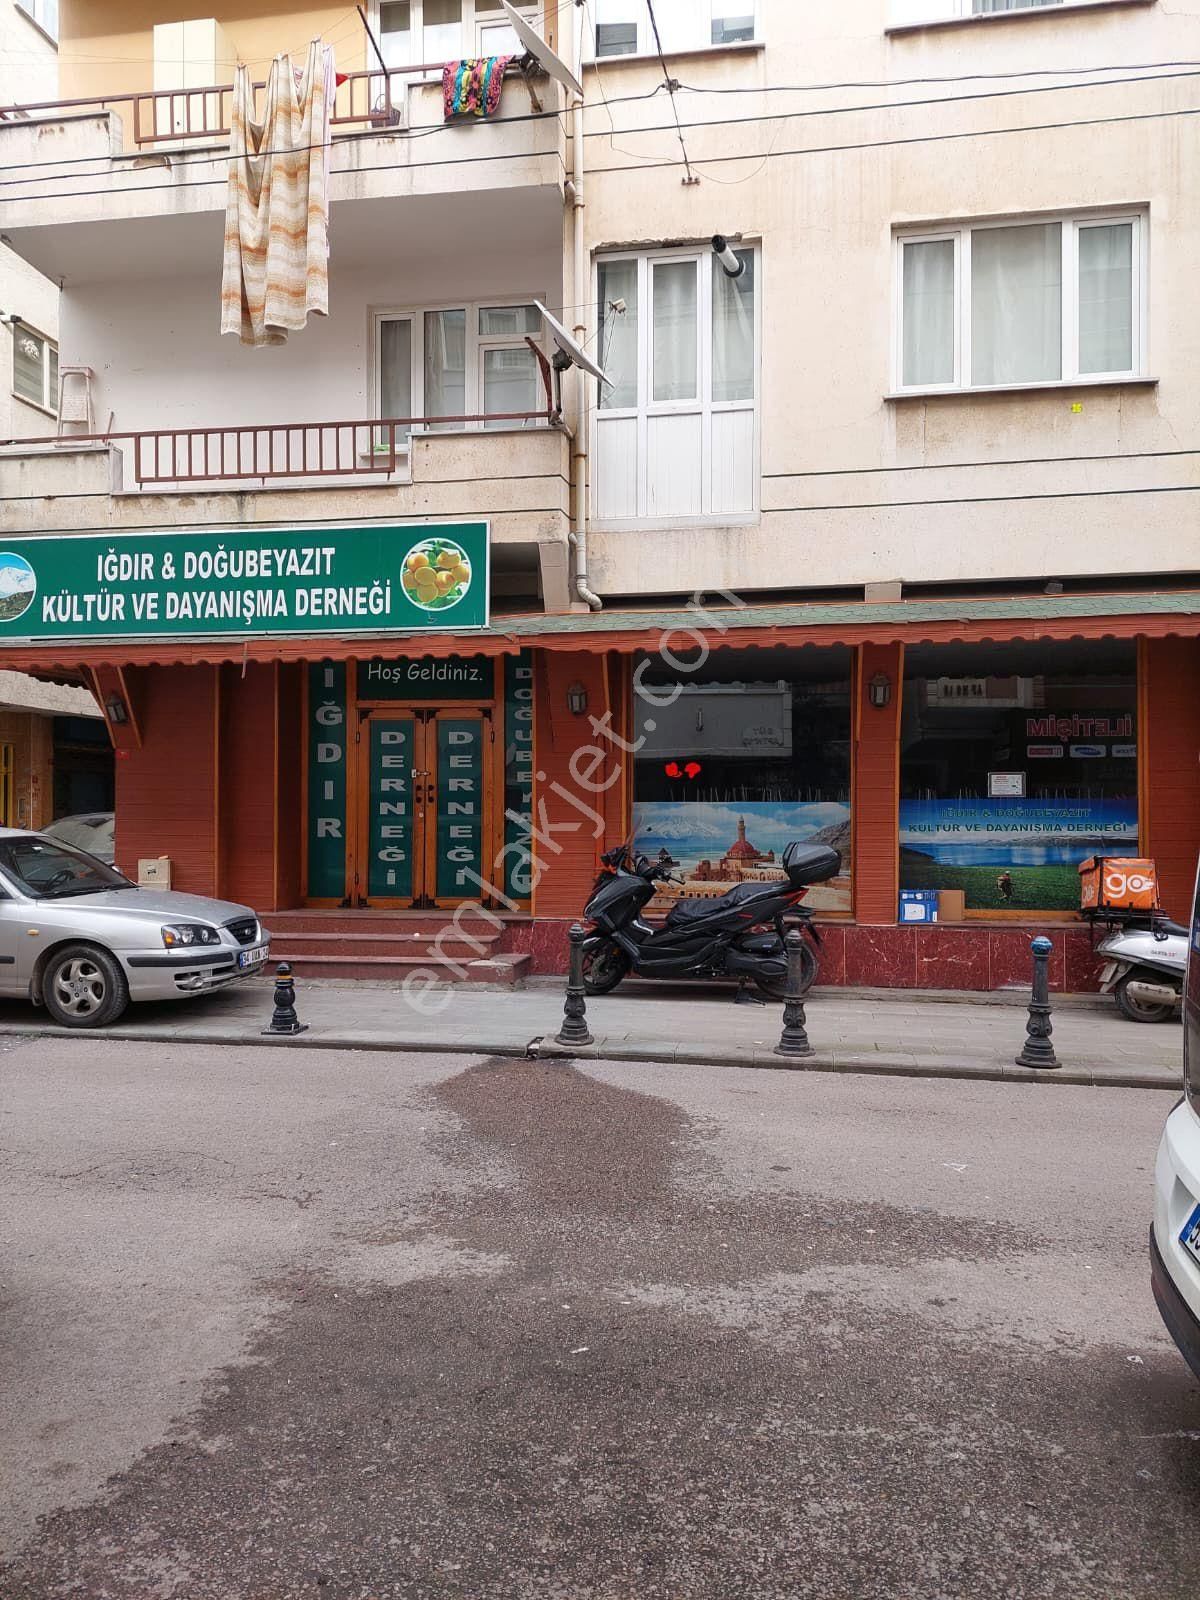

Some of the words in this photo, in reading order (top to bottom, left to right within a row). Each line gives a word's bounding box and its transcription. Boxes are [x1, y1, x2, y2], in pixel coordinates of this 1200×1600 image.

[97, 547, 154, 582] IĞDIR
[161, 551, 176, 580] &
[184, 543, 336, 580] DOĞUBEYAZIT
[42, 588, 126, 623] KÜLTÜR
[132, 592, 159, 621] VE
[166, 589, 288, 625] DAYANIŞMA
[295, 578, 391, 617] DERNEĞİ
[368, 664, 401, 683] Hoş
[407, 663, 483, 681] Geldiniz.
[315, 668, 343, 838] IĞDIR
[378, 731, 407, 885] DERNEĞİ
[446, 731, 475, 885] DERNEĞİ
[965, 822, 981, 832] VE
[985, 822, 1063, 833] DAYANIŞMA
